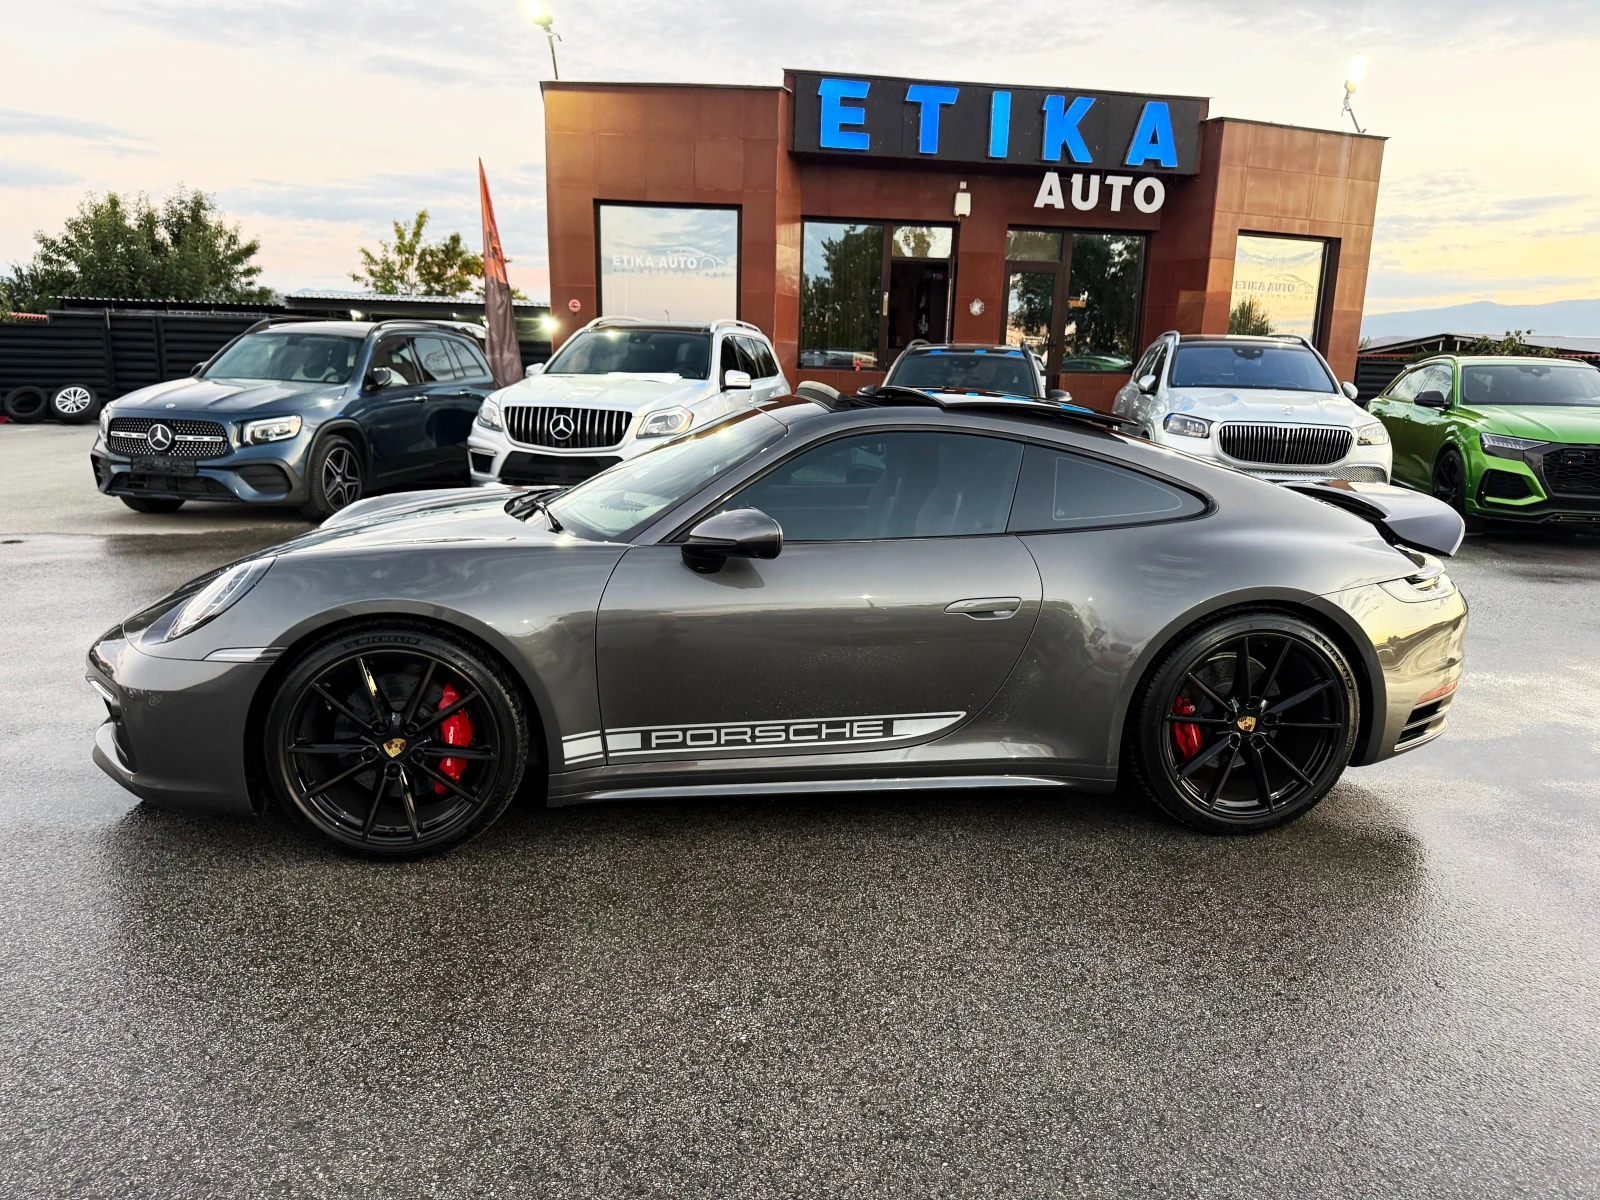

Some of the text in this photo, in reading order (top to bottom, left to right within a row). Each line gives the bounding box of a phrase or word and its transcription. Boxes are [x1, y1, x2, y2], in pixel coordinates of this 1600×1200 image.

[817, 78, 1179, 168] ETIKA
[1033, 171, 1166, 214] AUTO
[612, 255, 698, 269] ETIKA AUTO
[1234, 280, 1297, 293] ETIKA AUTO
[358, 635, 418, 645] MICHELIN
[650, 719, 885, 748] PORSCHE
